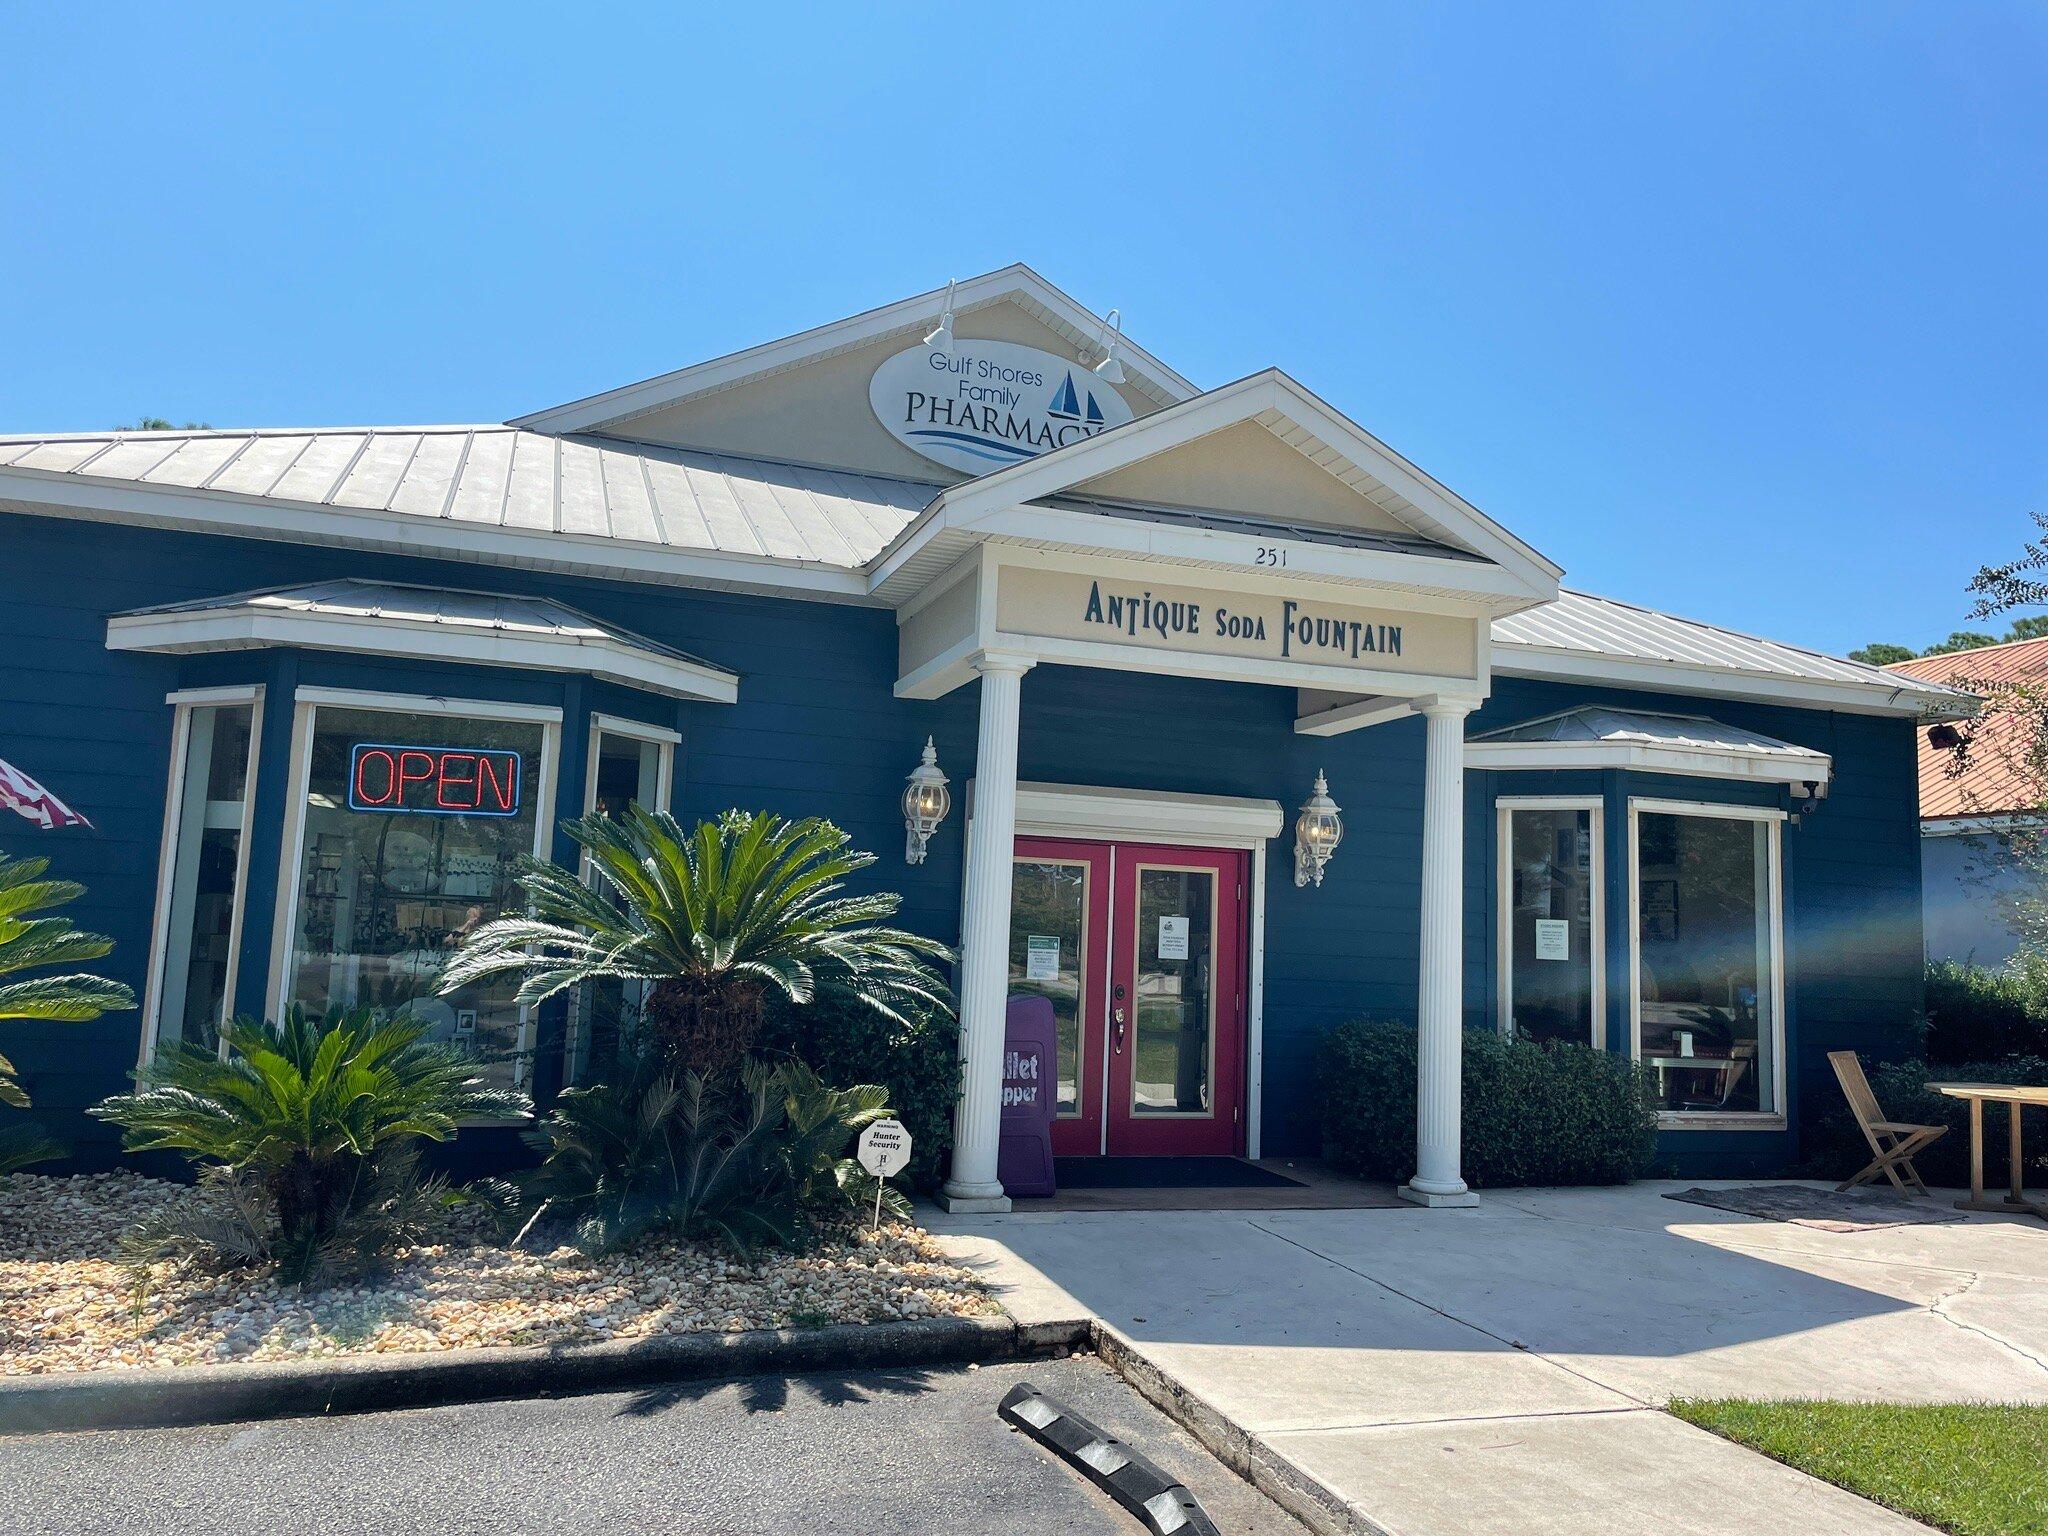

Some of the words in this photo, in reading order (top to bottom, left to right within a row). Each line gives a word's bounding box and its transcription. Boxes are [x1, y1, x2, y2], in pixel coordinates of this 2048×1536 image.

[929, 352, 972, 376] Gulf
[978, 359, 1043, 387] Shores
[958, 380, 1021, 411] Family
[1254, 547, 1287, 568] 251
[1215, 608, 1267, 641] SODA
[1281, 600, 1402, 659] FOUNTAIN
[357, 751, 513, 808] OPEN
[1003, 1051, 1038, 1080] llet
[1001, 1086, 1038, 1107] pper
[868, 1140, 901, 1150] Security
[873, 1132, 901, 1140] Hunter
